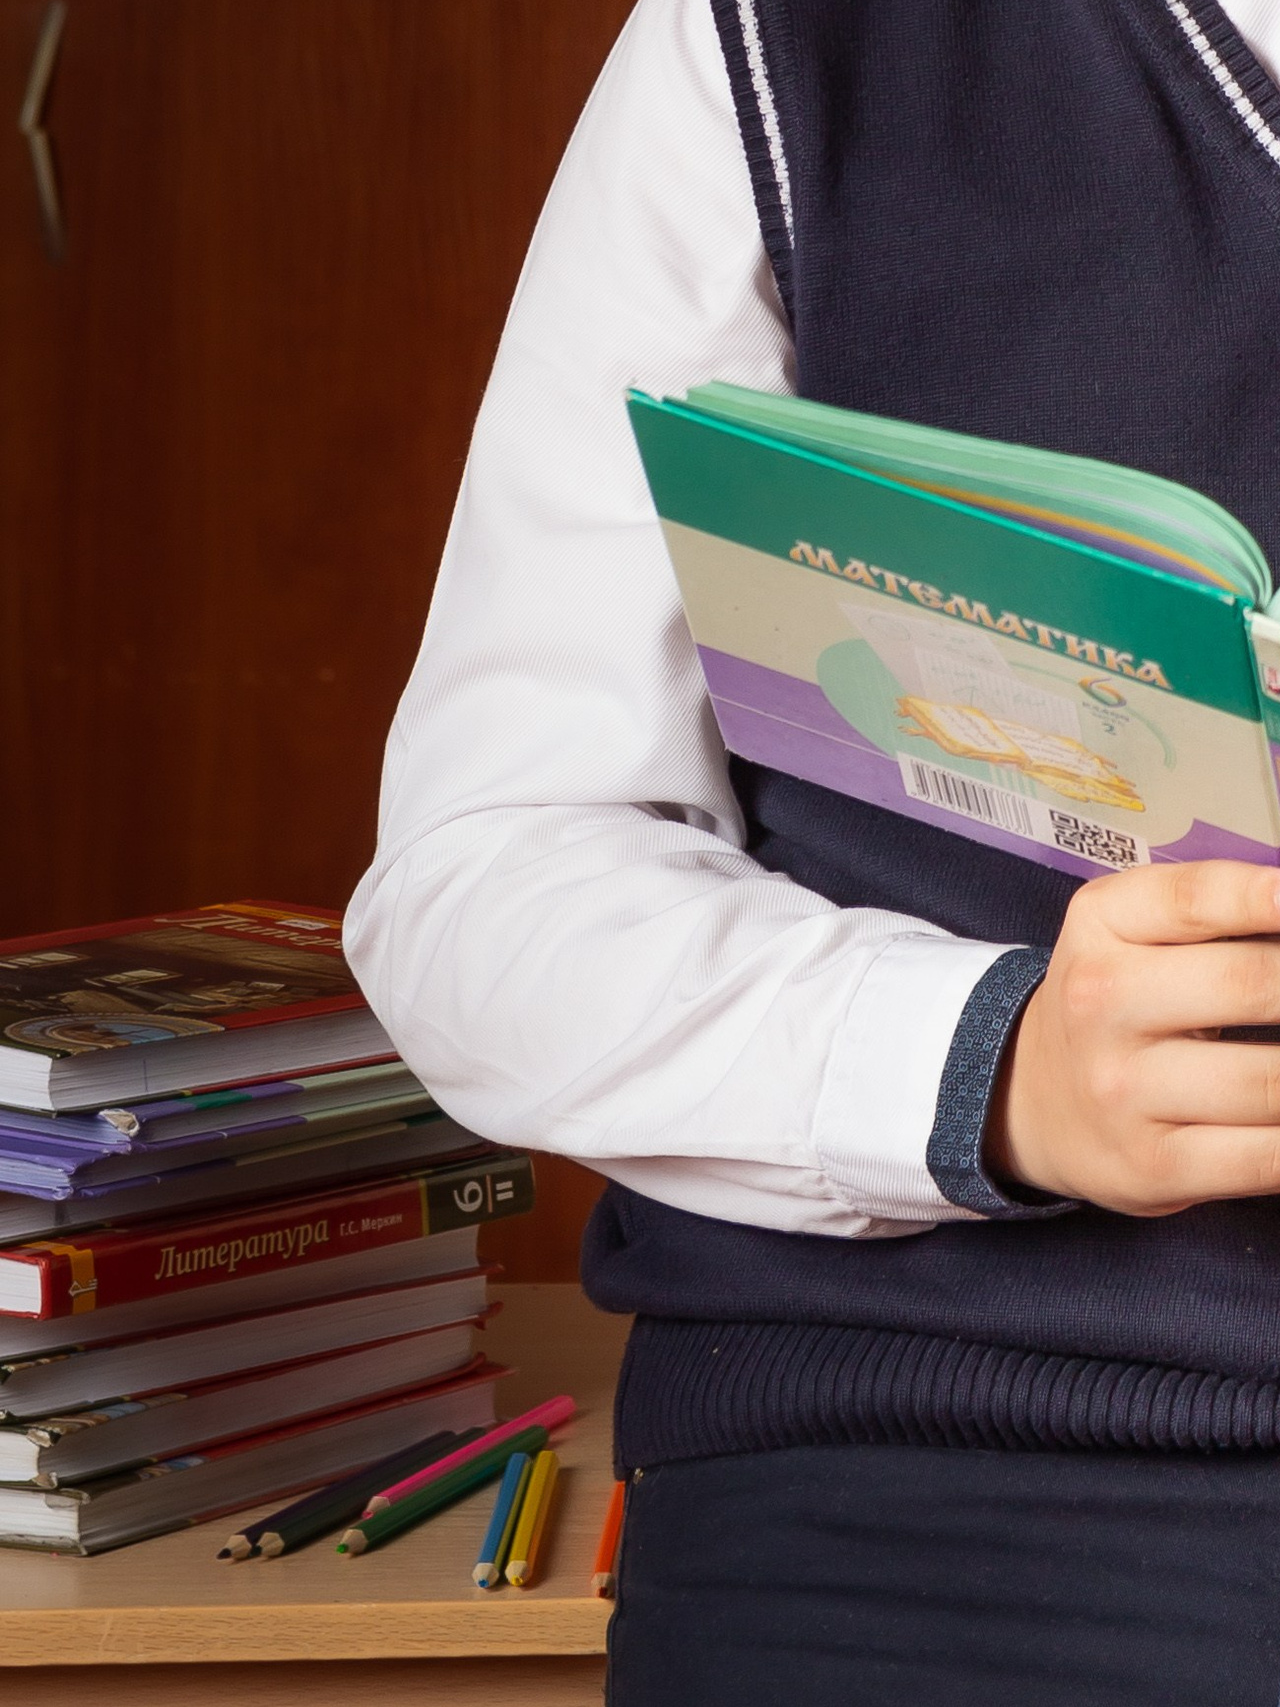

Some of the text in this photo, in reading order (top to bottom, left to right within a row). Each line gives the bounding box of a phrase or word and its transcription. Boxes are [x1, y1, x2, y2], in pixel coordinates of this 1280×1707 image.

[789, 539, 1174, 691] МАТЕМАТИКА
[453, 1181, 483, 1212] 6
[155, 1219, 330, 1280] Литература
[340, 1220, 359, 1237] Г.С.
